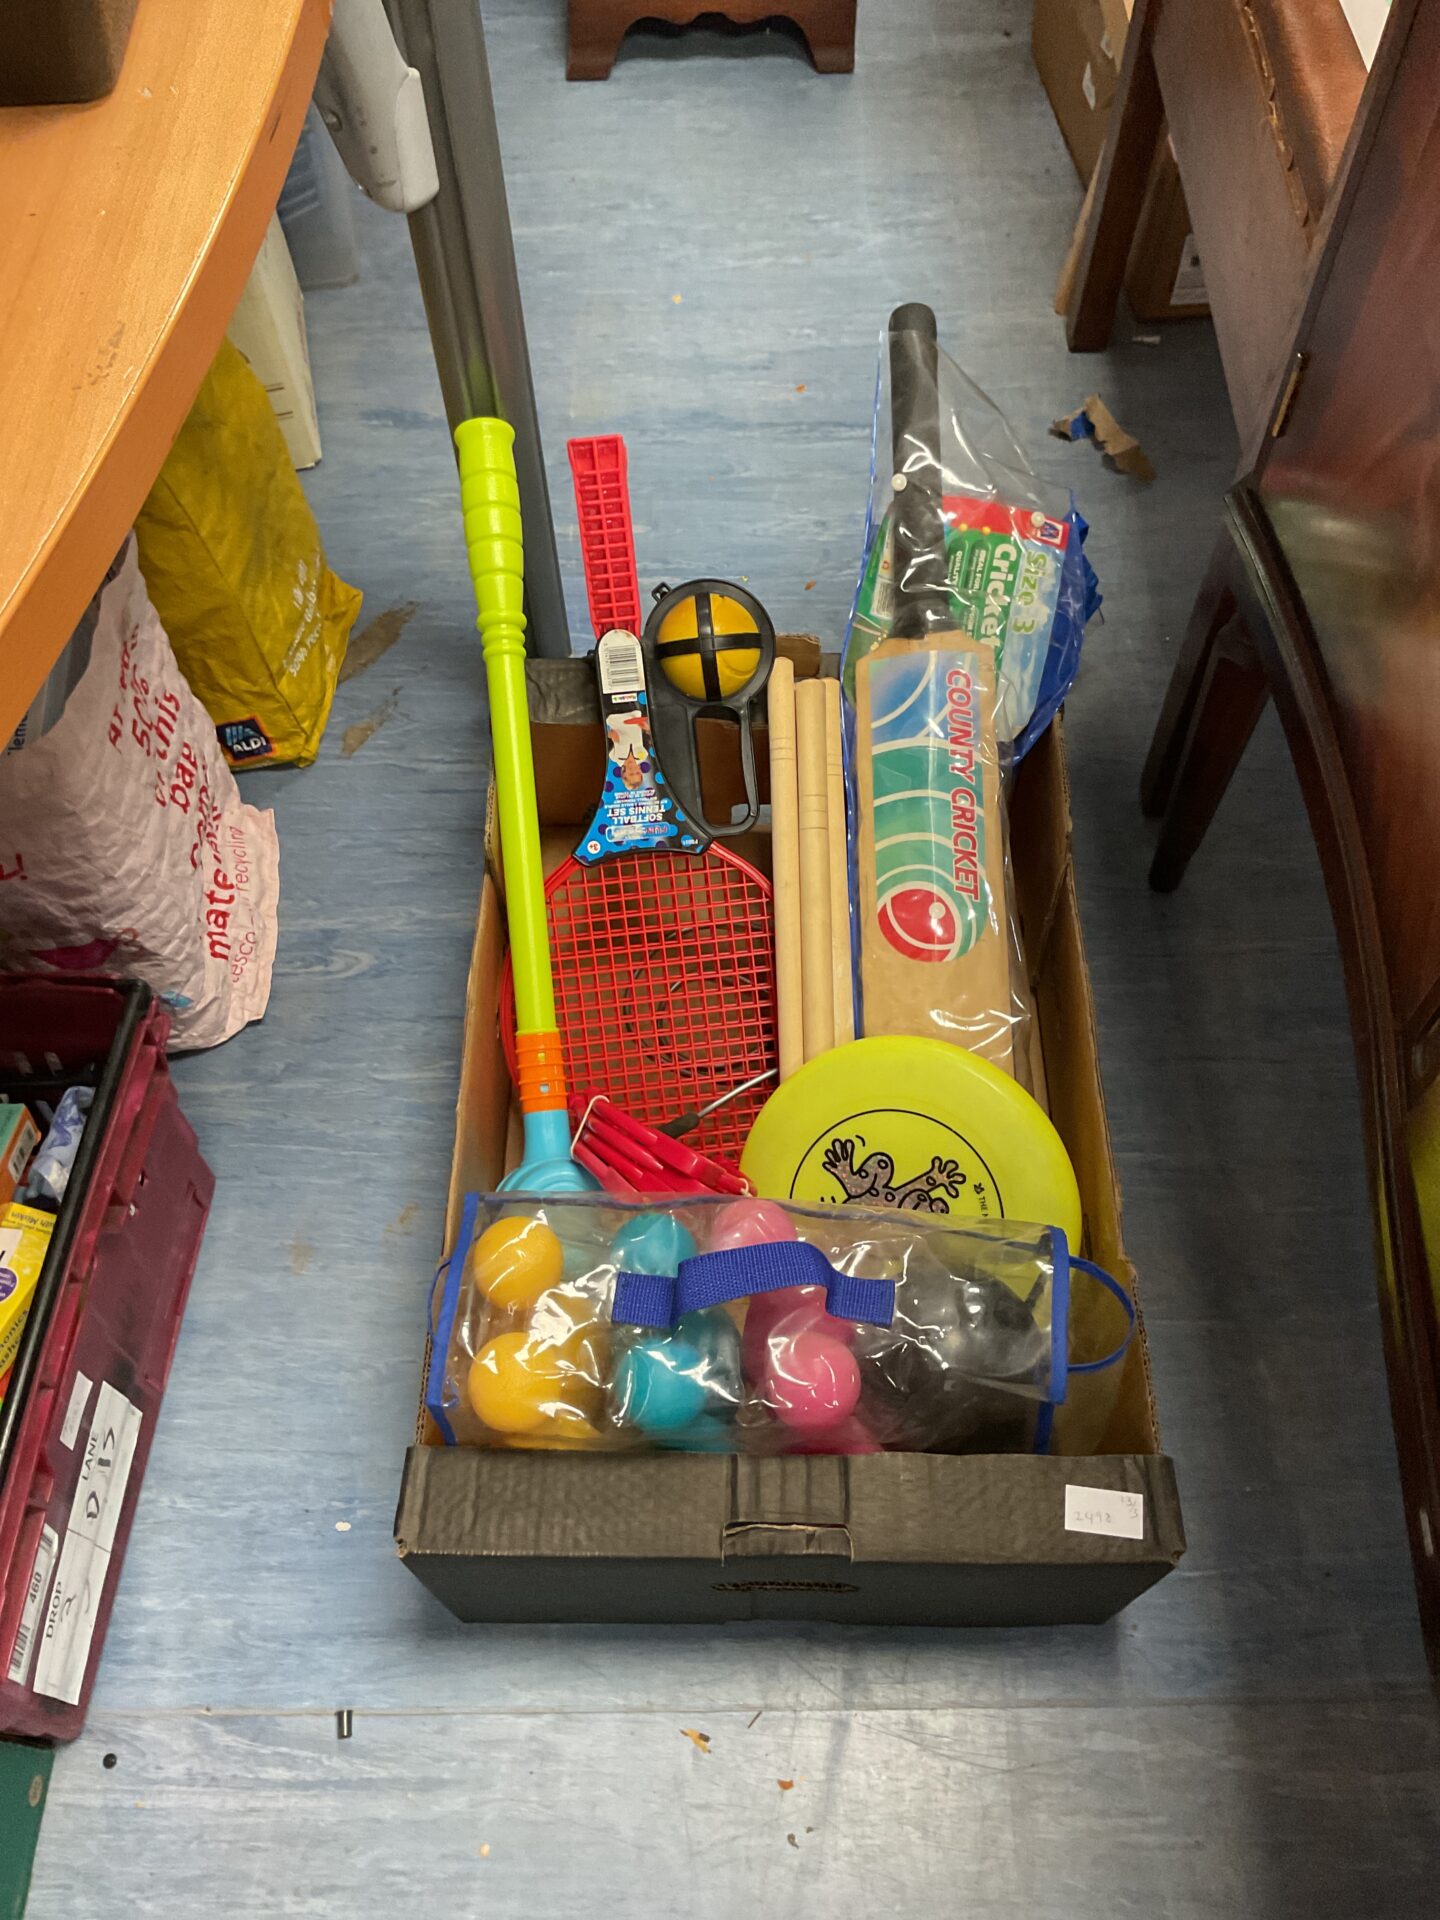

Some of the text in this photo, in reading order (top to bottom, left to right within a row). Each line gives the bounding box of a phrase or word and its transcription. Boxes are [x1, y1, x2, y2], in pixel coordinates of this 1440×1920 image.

[980, 543, 1017, 648] Cricket
[233, 736, 267, 752] ALDI
[945, 668, 980, 902] COUNTY CRICKET
[606, 807, 627, 817] SET
[611, 813, 663, 825] SOFTBALL
[629, 804, 666, 815] TENNIS
[82, 1434, 98, 1481] LANE
[29, 1571, 42, 1604] 460
[46, 1581, 62, 1639] DROP
